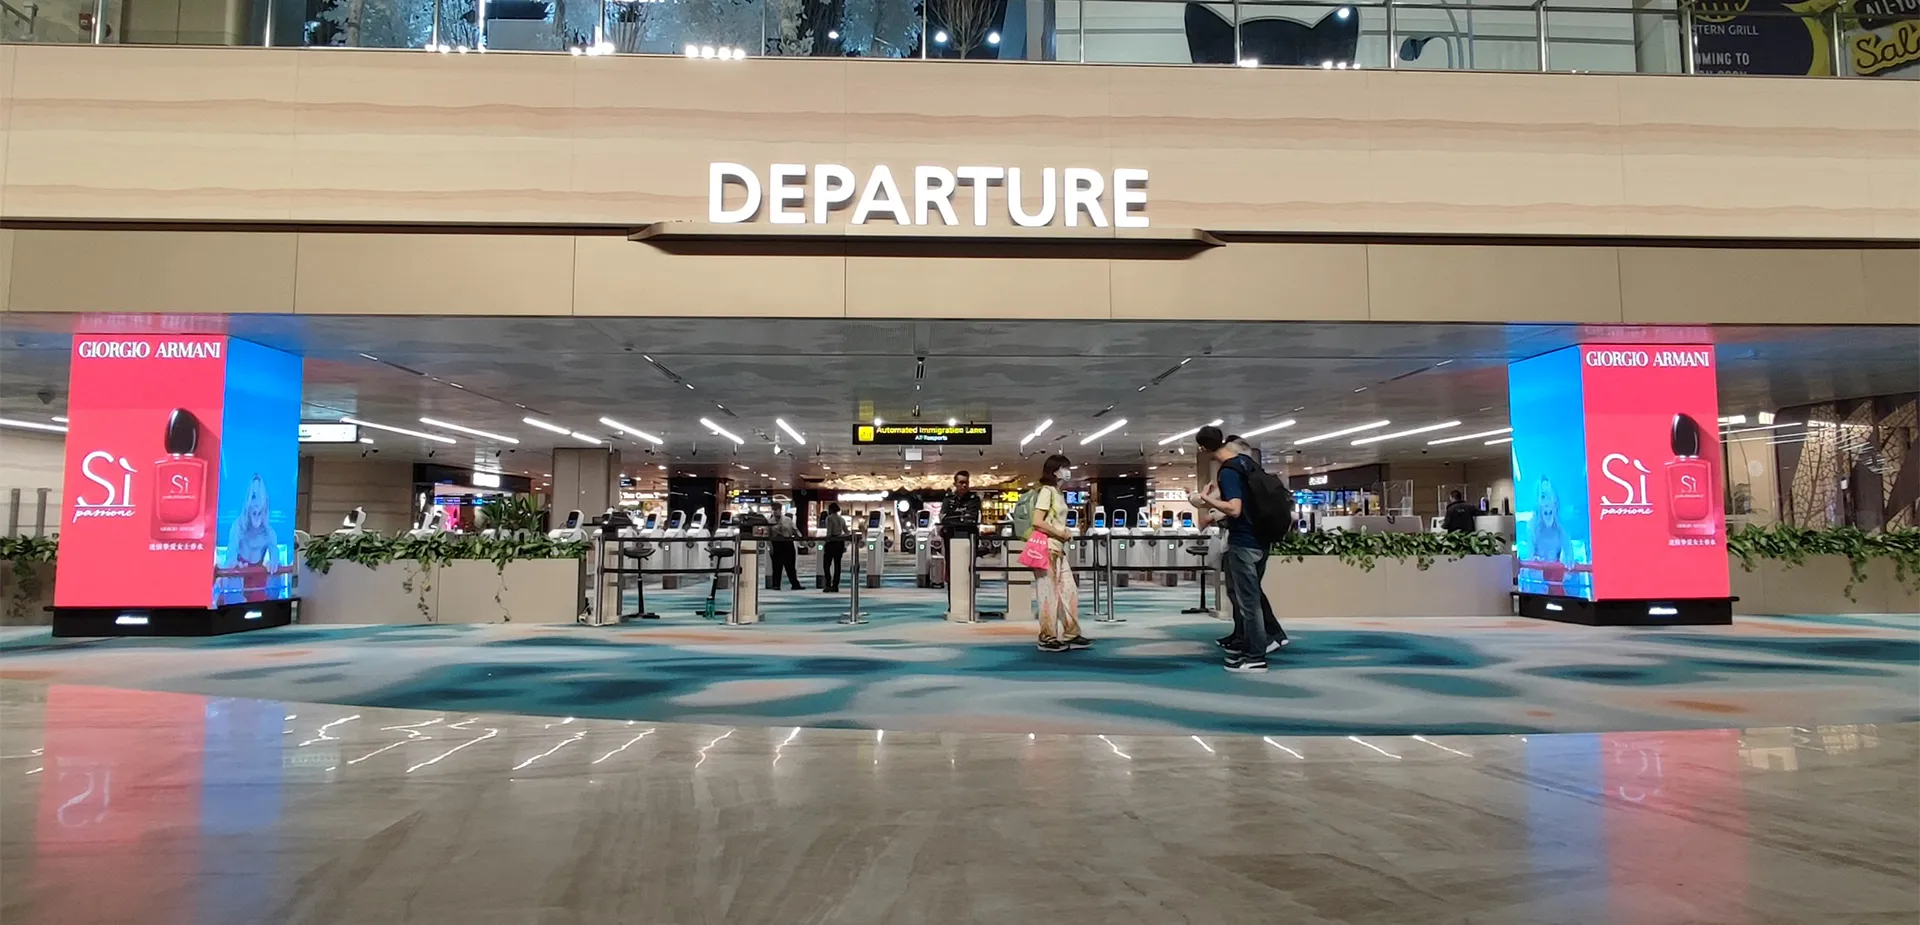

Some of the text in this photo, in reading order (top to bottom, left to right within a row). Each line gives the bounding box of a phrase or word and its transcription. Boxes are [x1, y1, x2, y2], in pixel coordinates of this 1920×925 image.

[1728, 24, 1760, 35] GRILL
[1694, 52, 1750, 65] OMING TO
[708, 161, 1151, 229] DEPARTURE
[78, 341, 221, 358] GIORGIO ARMANI
[1585, 351, 1710, 367] GIORGIO ARMANI
[876, 426, 986, 435] Automated Immigration Lanes
[77, 450, 138, 506] Sì
[1601, 453, 1652, 505] Sì
[72, 509, 136, 523] passione
[1600, 508, 1654, 521] passione
